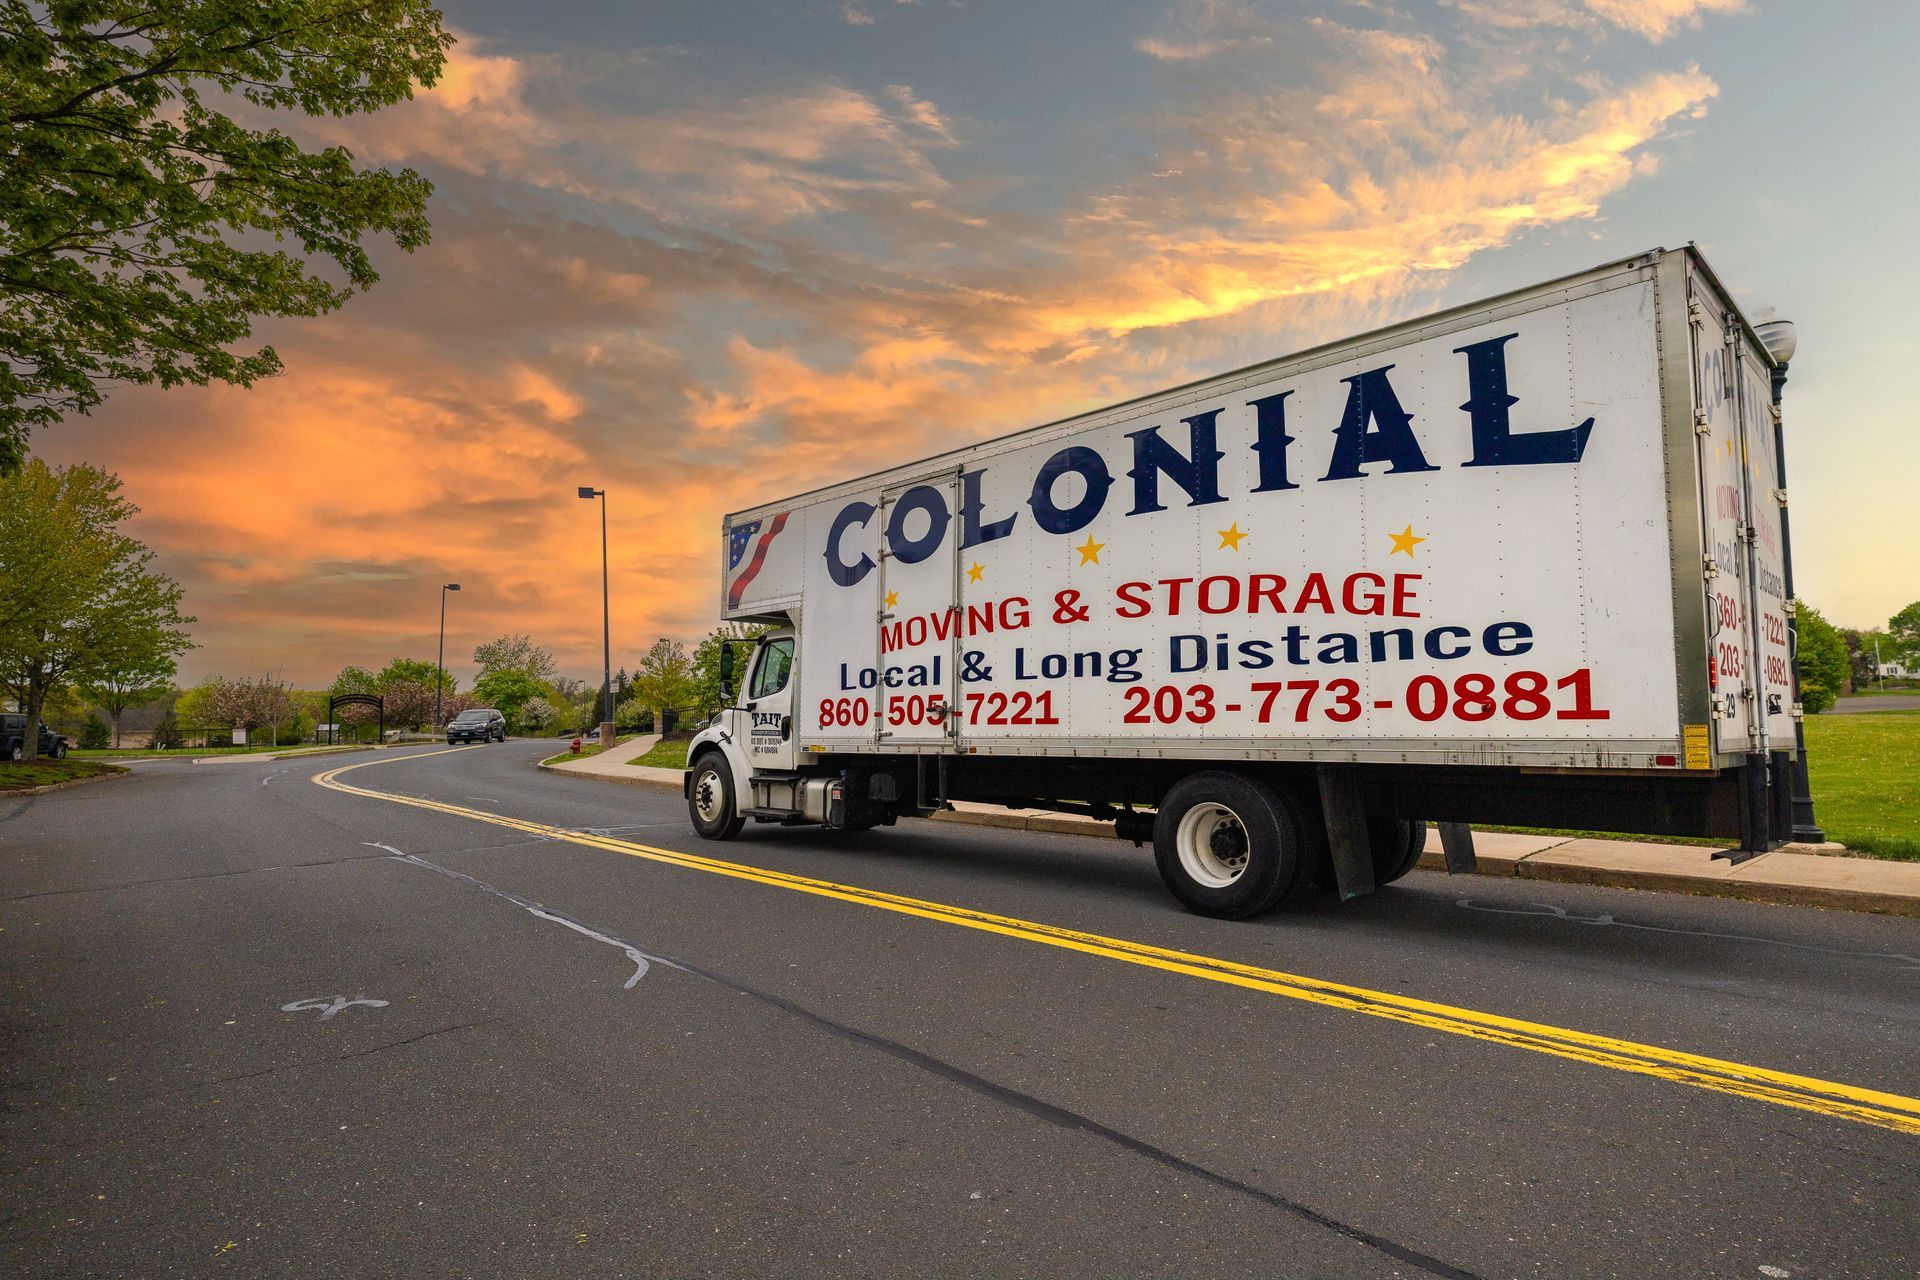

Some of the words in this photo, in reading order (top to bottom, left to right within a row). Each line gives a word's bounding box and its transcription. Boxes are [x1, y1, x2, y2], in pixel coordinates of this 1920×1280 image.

[823, 333, 1595, 587] COLONIAL
[881, 597, 1030, 654] MOVING
[1052, 589, 1090, 625] &
[1115, 573, 1422, 618] STORAGE
[840, 655, 942, 691] Local
[961, 650, 993, 683] &
[1015, 646, 1143, 683] Long
[1170, 621, 1534, 674] Distance
[751, 712, 782, 728] TAIT
[819, 690, 1059, 727] 860-505-7221
[1123, 668, 1610, 724] 203-773-0881
[1726, 693, 1736, 718] 29
